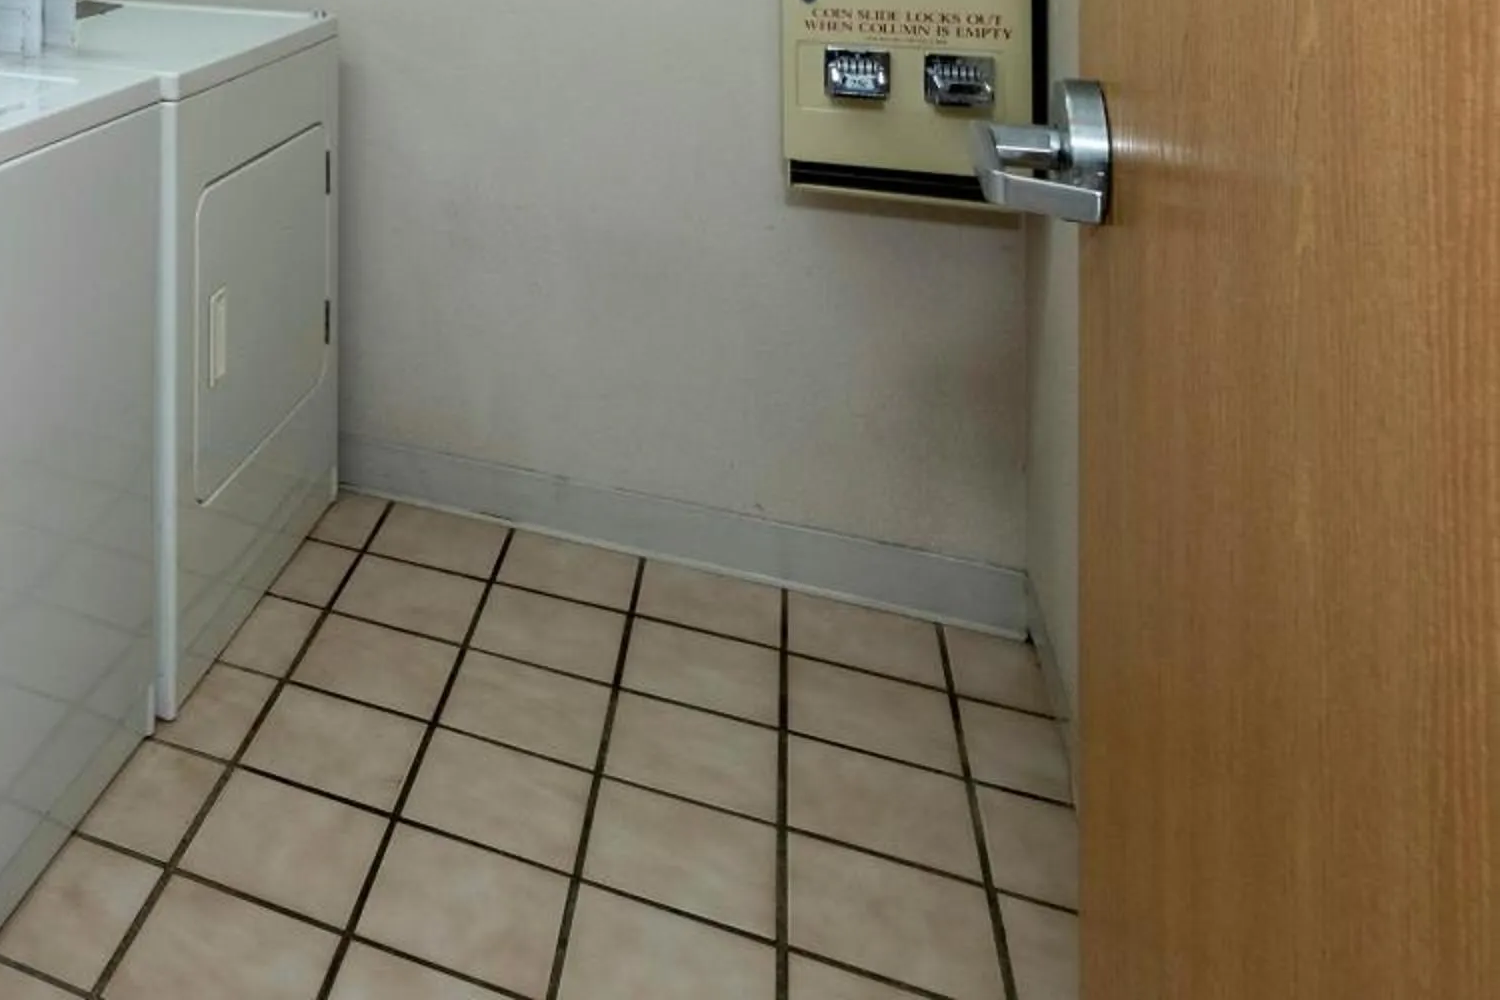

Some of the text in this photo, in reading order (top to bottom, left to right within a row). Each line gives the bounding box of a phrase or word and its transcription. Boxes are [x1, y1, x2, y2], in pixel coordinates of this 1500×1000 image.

[811, 7, 1004, 26] COIN SLIDE LOCKS OUT
[803, 18, 853, 32] WHEN
[858, 20, 930, 37] COLUMN
[936, 25, 950, 37] IS
[955, 26, 1013, 40] EMPTY
